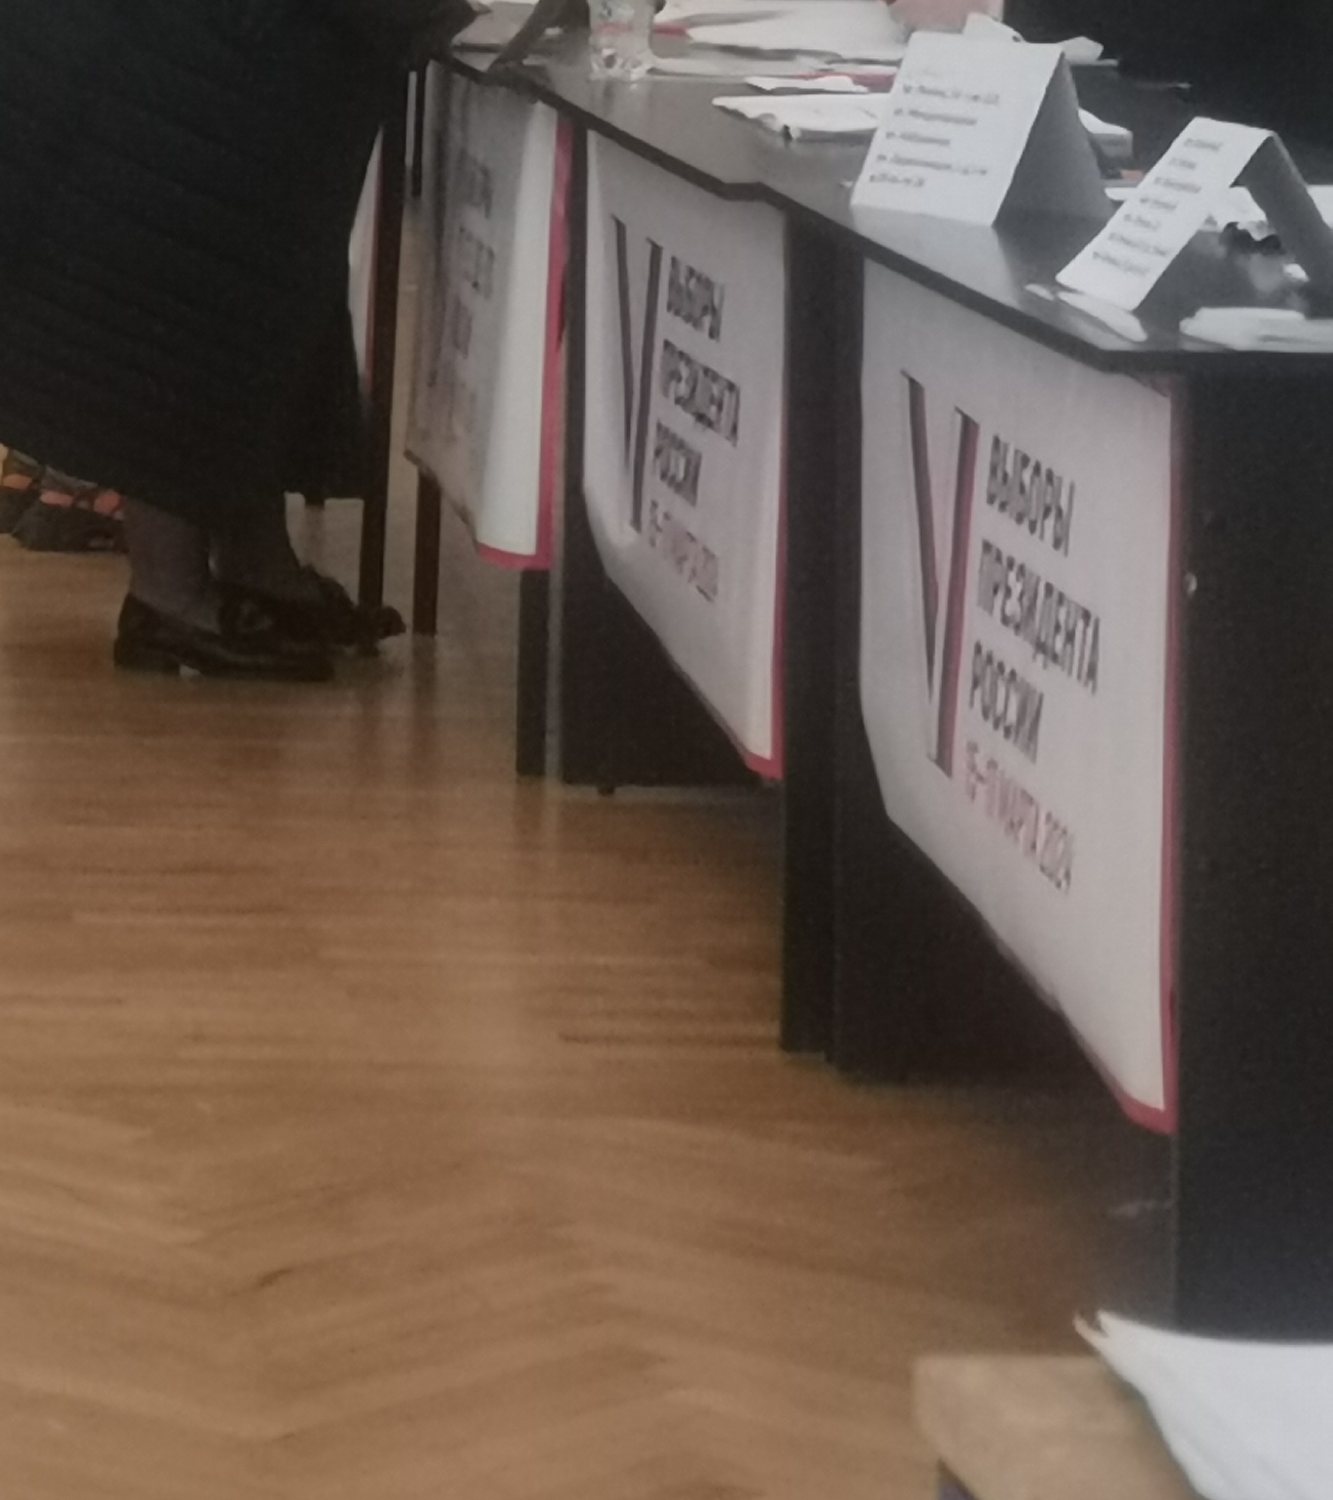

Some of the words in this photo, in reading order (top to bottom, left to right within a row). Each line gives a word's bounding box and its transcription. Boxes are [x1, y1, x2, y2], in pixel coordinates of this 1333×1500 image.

[985, 434, 1075, 557] ВЫБОРЫ
[976, 537, 1101, 697] ПРЕЗИДЕНТА
[968, 640, 1044, 765] РОССИИ
